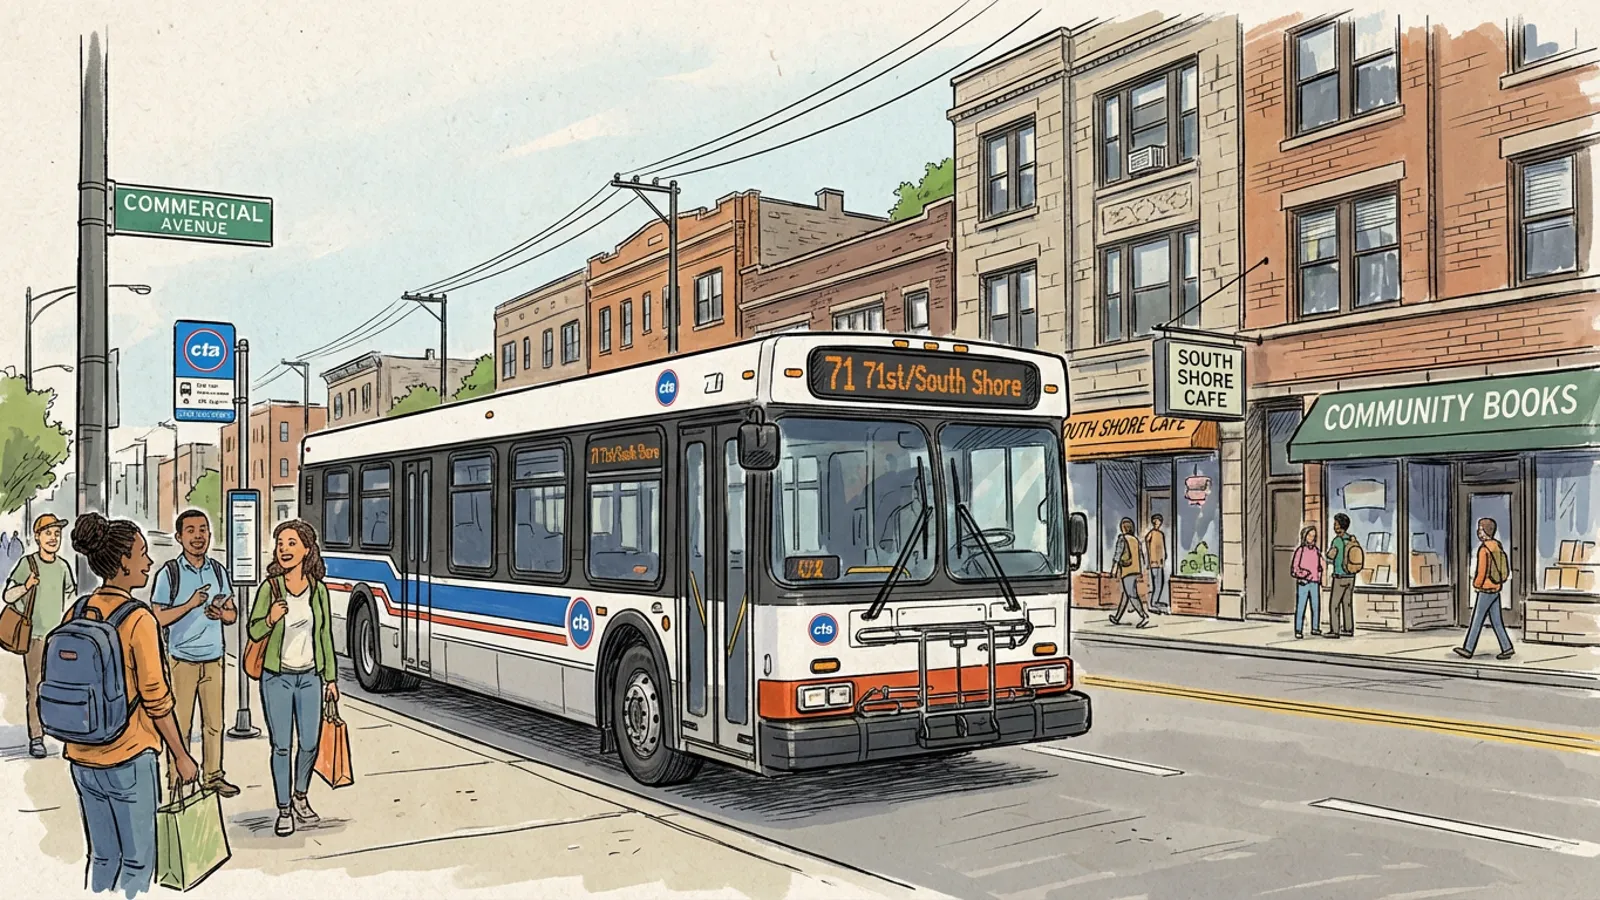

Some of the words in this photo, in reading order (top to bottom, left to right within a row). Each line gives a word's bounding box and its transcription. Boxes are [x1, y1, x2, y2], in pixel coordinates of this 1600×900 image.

[124, 194, 264, 223] COMMERCIAL
[161, 217, 228, 235] AVENUE
[191, 342, 220, 357] cta
[1178, 349, 1233, 370] SOUTH
[825, 356, 855, 391] 71
[863, 361, 967, 394] 71st/South
[972, 368, 1022, 397] Shore
[1177, 369, 1234, 389] SHORE
[1184, 389, 1227, 408] CAFE
[1324, 392, 1474, 430] COMMUNITY
[1483, 383, 1579, 420] BOOKS
[1063, 420, 1099, 440] OUTH
[1099, 415, 1149, 437] SHORE
